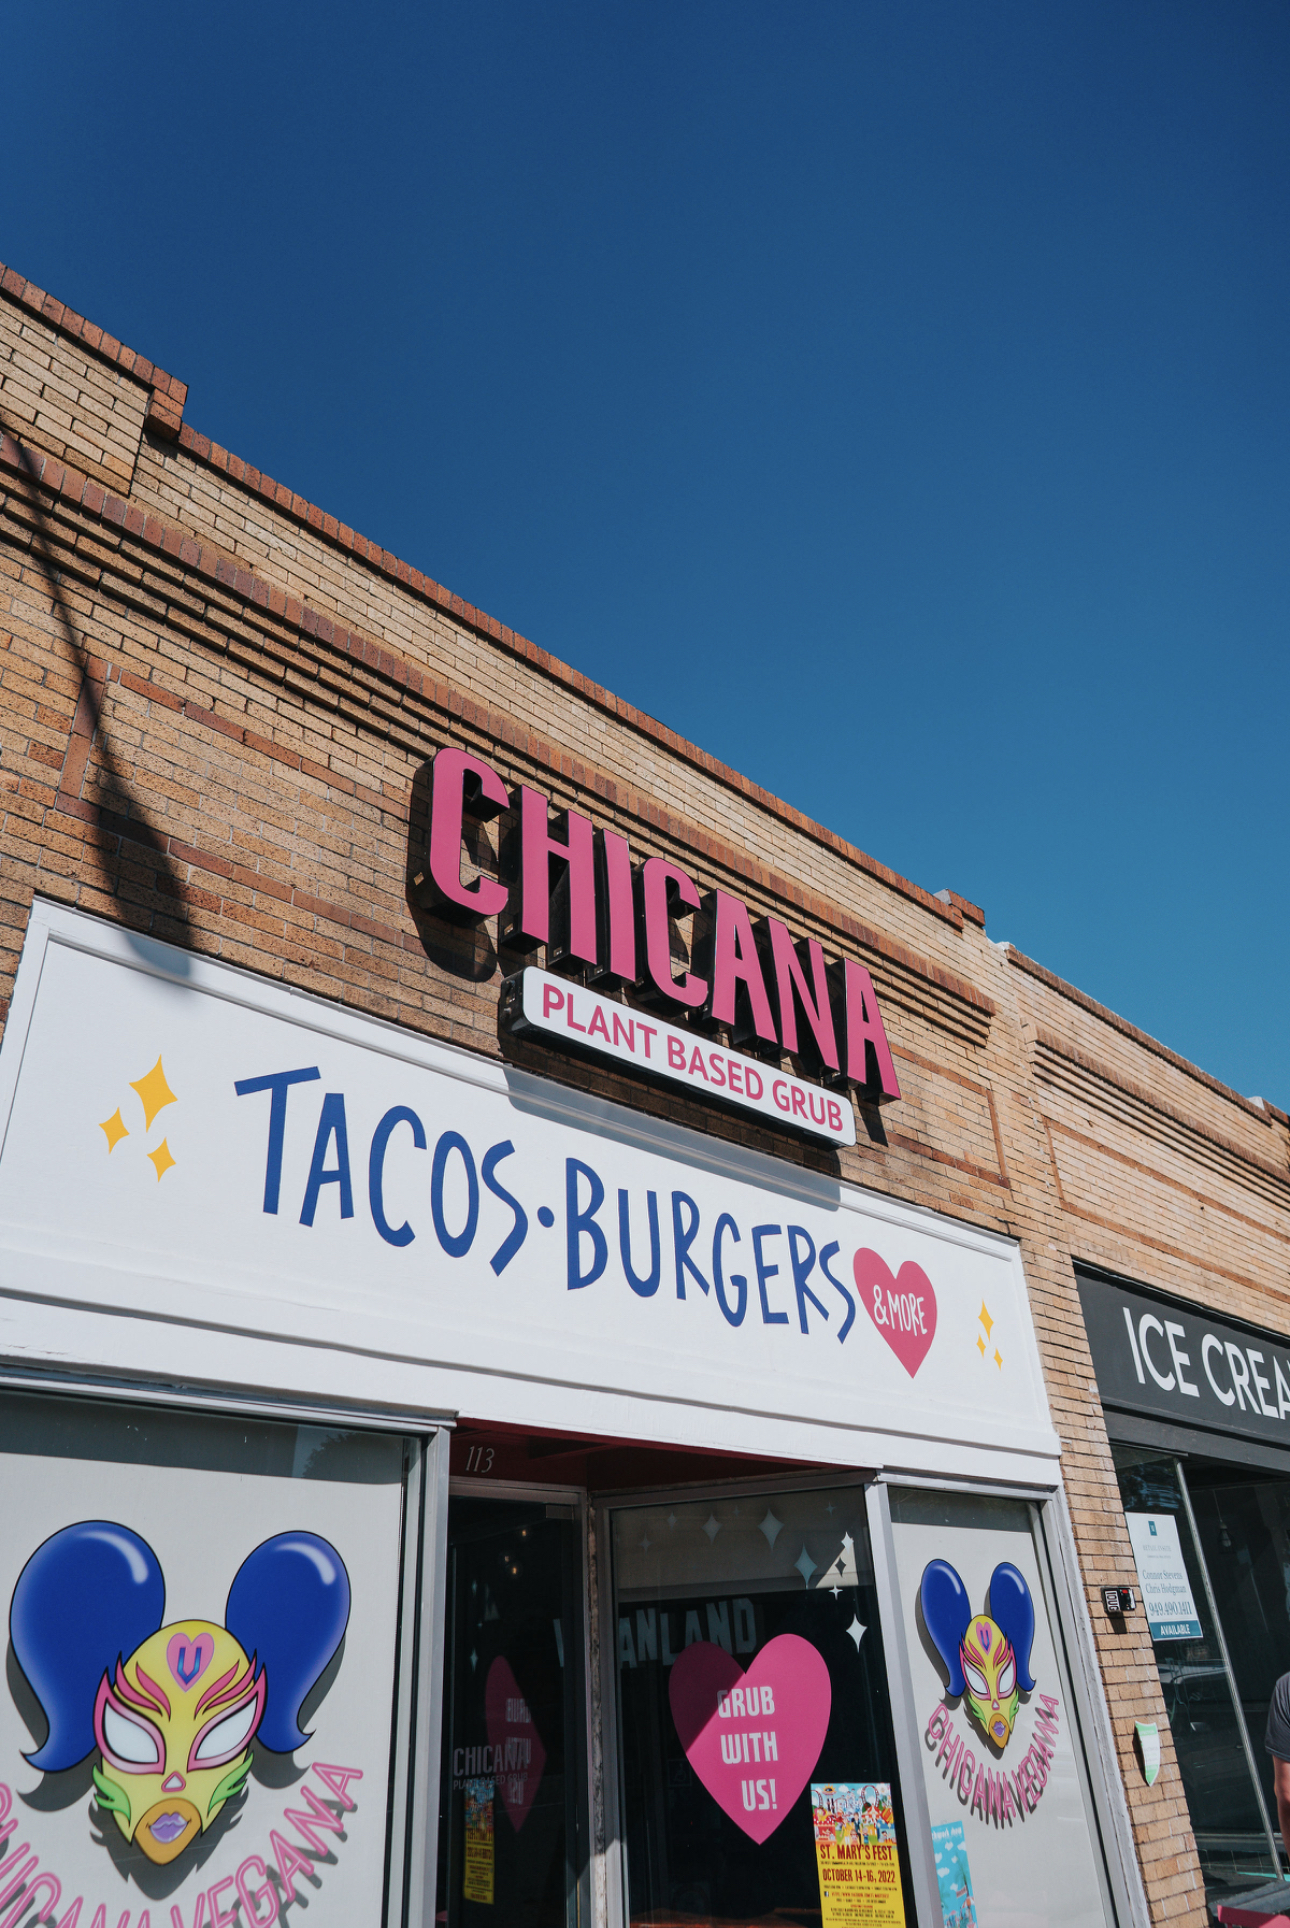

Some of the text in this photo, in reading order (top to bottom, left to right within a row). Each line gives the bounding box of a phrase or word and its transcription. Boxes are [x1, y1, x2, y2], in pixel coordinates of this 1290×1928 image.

[429, 747, 902, 1101] CHICANA
[542, 982, 844, 1132] PLANT BASED GRUB
[234, 1066, 857, 1345] TACOS BURGERS
[1122, 1306, 1290, 1421] ICE CREA
[465, 1445, 495, 1474] 113
[1142, 1569, 1183, 1580] Connor Stevens
[1145, 1583, 1161, 1594] Chris
[1160, 1623, 1191, 1636] AVAILABLE
[716, 1685, 776, 1719] GRUB
[453, 1744, 529, 1777] CHICANA
[720, 1731, 779, 1765] WITH
[741, 1778, 778, 1812] US!
[820, 1844, 893, 1861] ST. MARY'S FEST
[822, 1868, 896, 1884] OCTOBER 14-16, 2022
